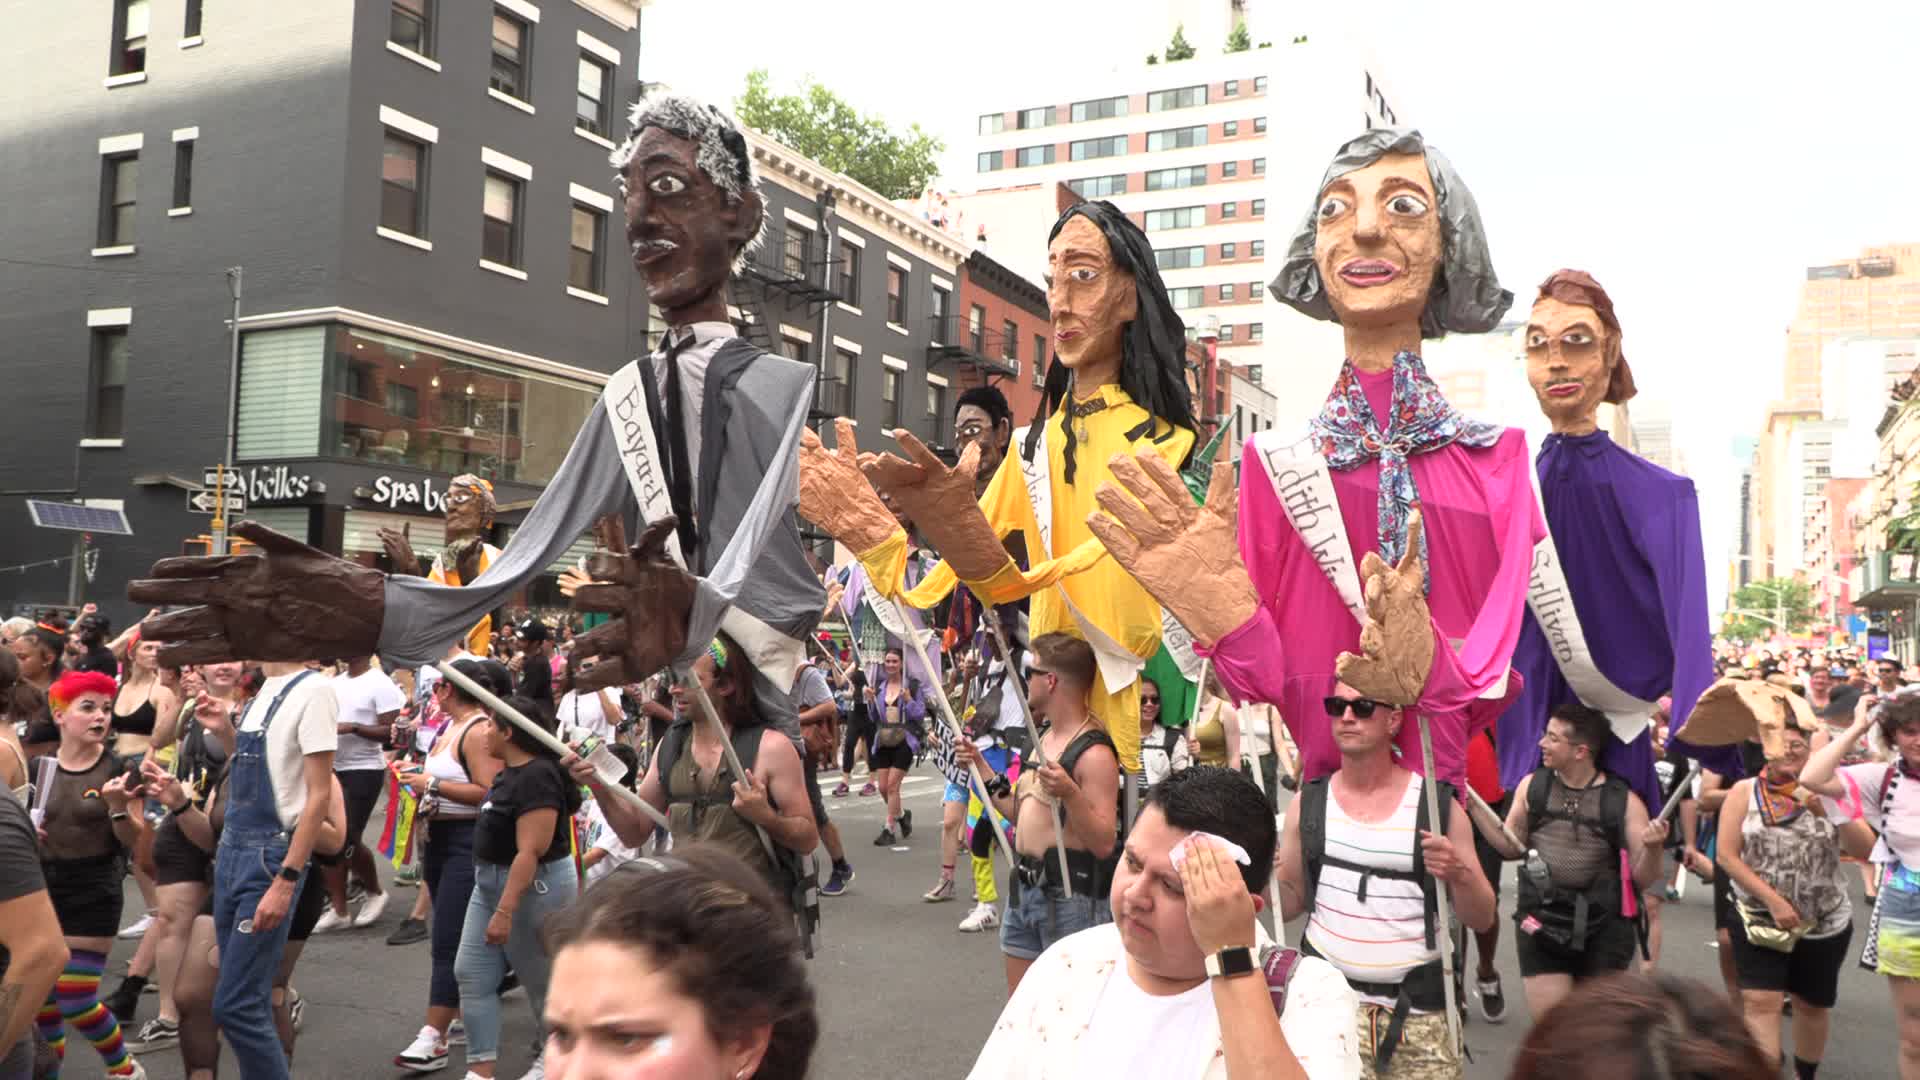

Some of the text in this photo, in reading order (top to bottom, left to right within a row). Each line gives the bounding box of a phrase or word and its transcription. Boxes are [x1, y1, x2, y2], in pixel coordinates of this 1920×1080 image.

[616, 384, 664, 510] Bayard
[249, 465, 310, 501] belles
[372, 475, 420, 508] Spa
[1263, 436, 1333, 532] Edith
